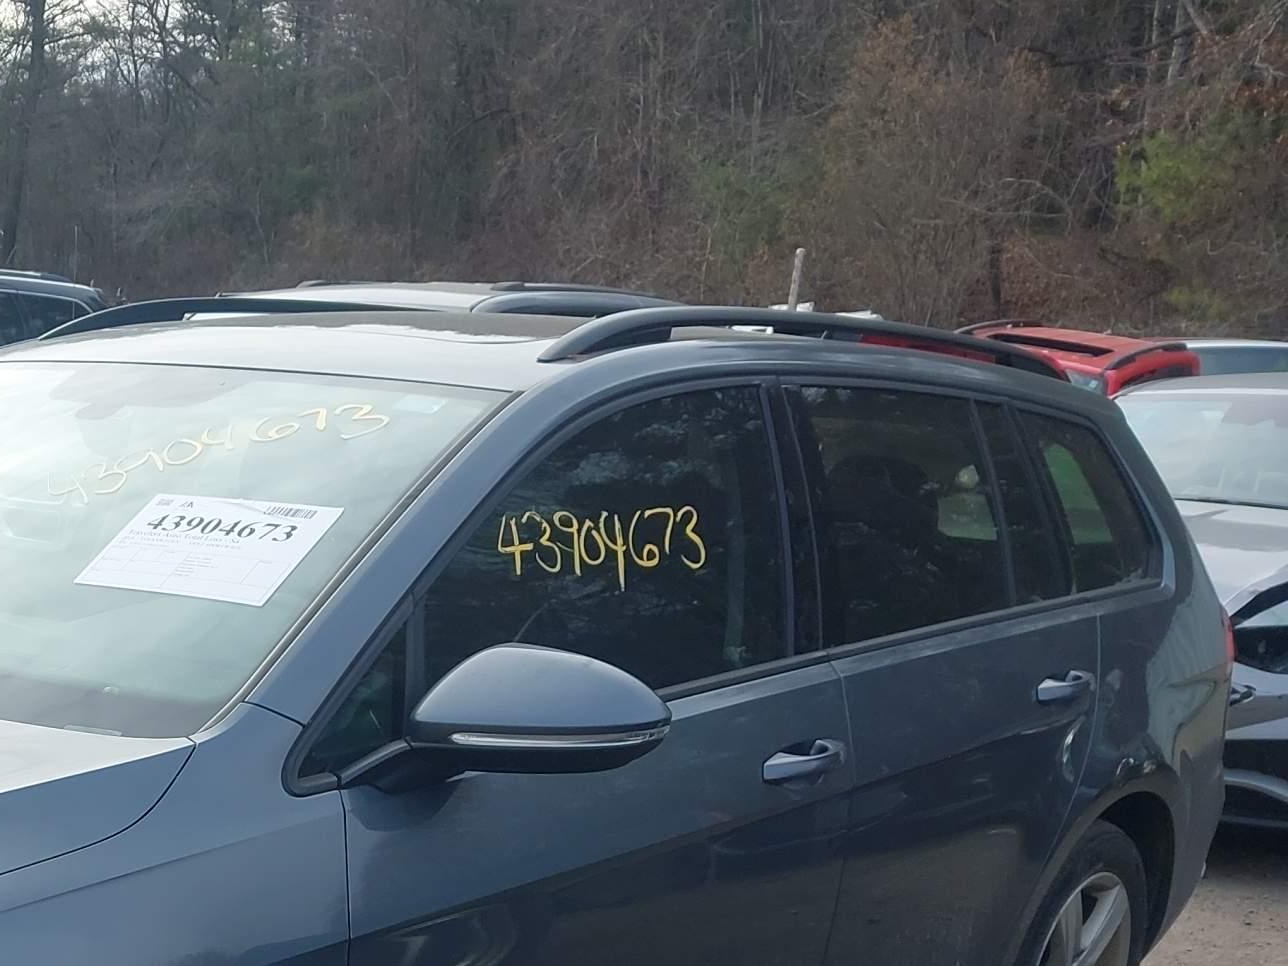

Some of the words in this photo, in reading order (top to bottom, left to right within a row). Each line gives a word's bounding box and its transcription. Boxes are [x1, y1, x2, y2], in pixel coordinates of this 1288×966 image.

[47, 402, 392, 505] 43904673
[146, 513, 299, 543] 43904673
[497, 504, 707, 592] 43904673
